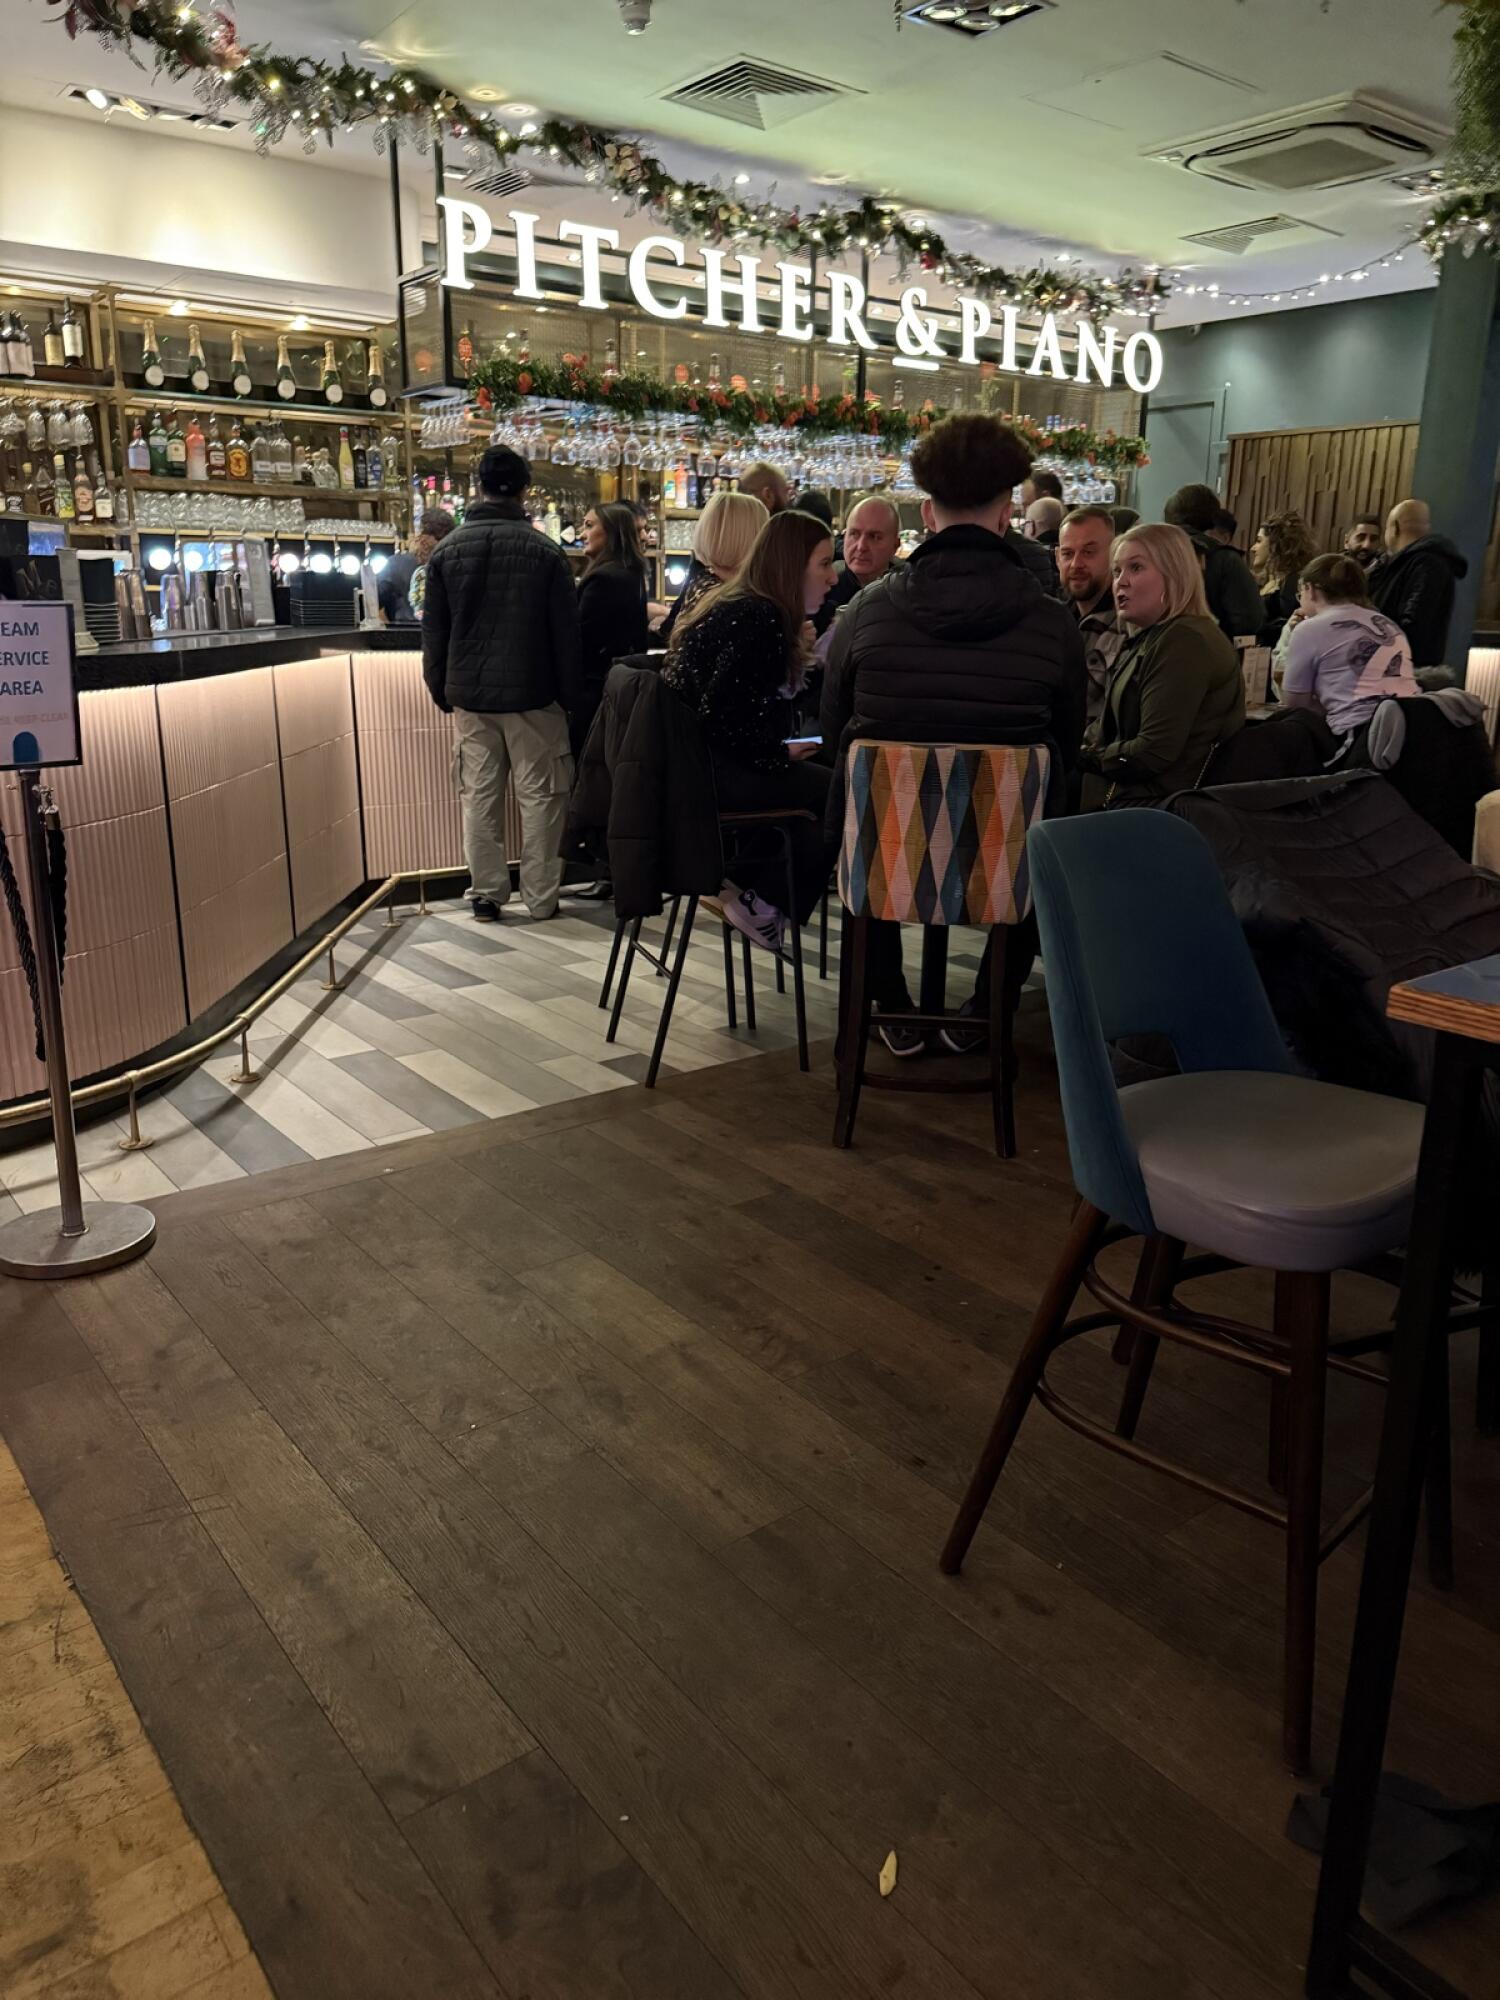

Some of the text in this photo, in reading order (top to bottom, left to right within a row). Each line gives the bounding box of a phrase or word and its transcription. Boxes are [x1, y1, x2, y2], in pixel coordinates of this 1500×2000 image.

[436, 196, 1164, 393] PITCHER & PIANO
[0, 621, 40, 637] EAM
[0, 680, 44, 696] AREA
